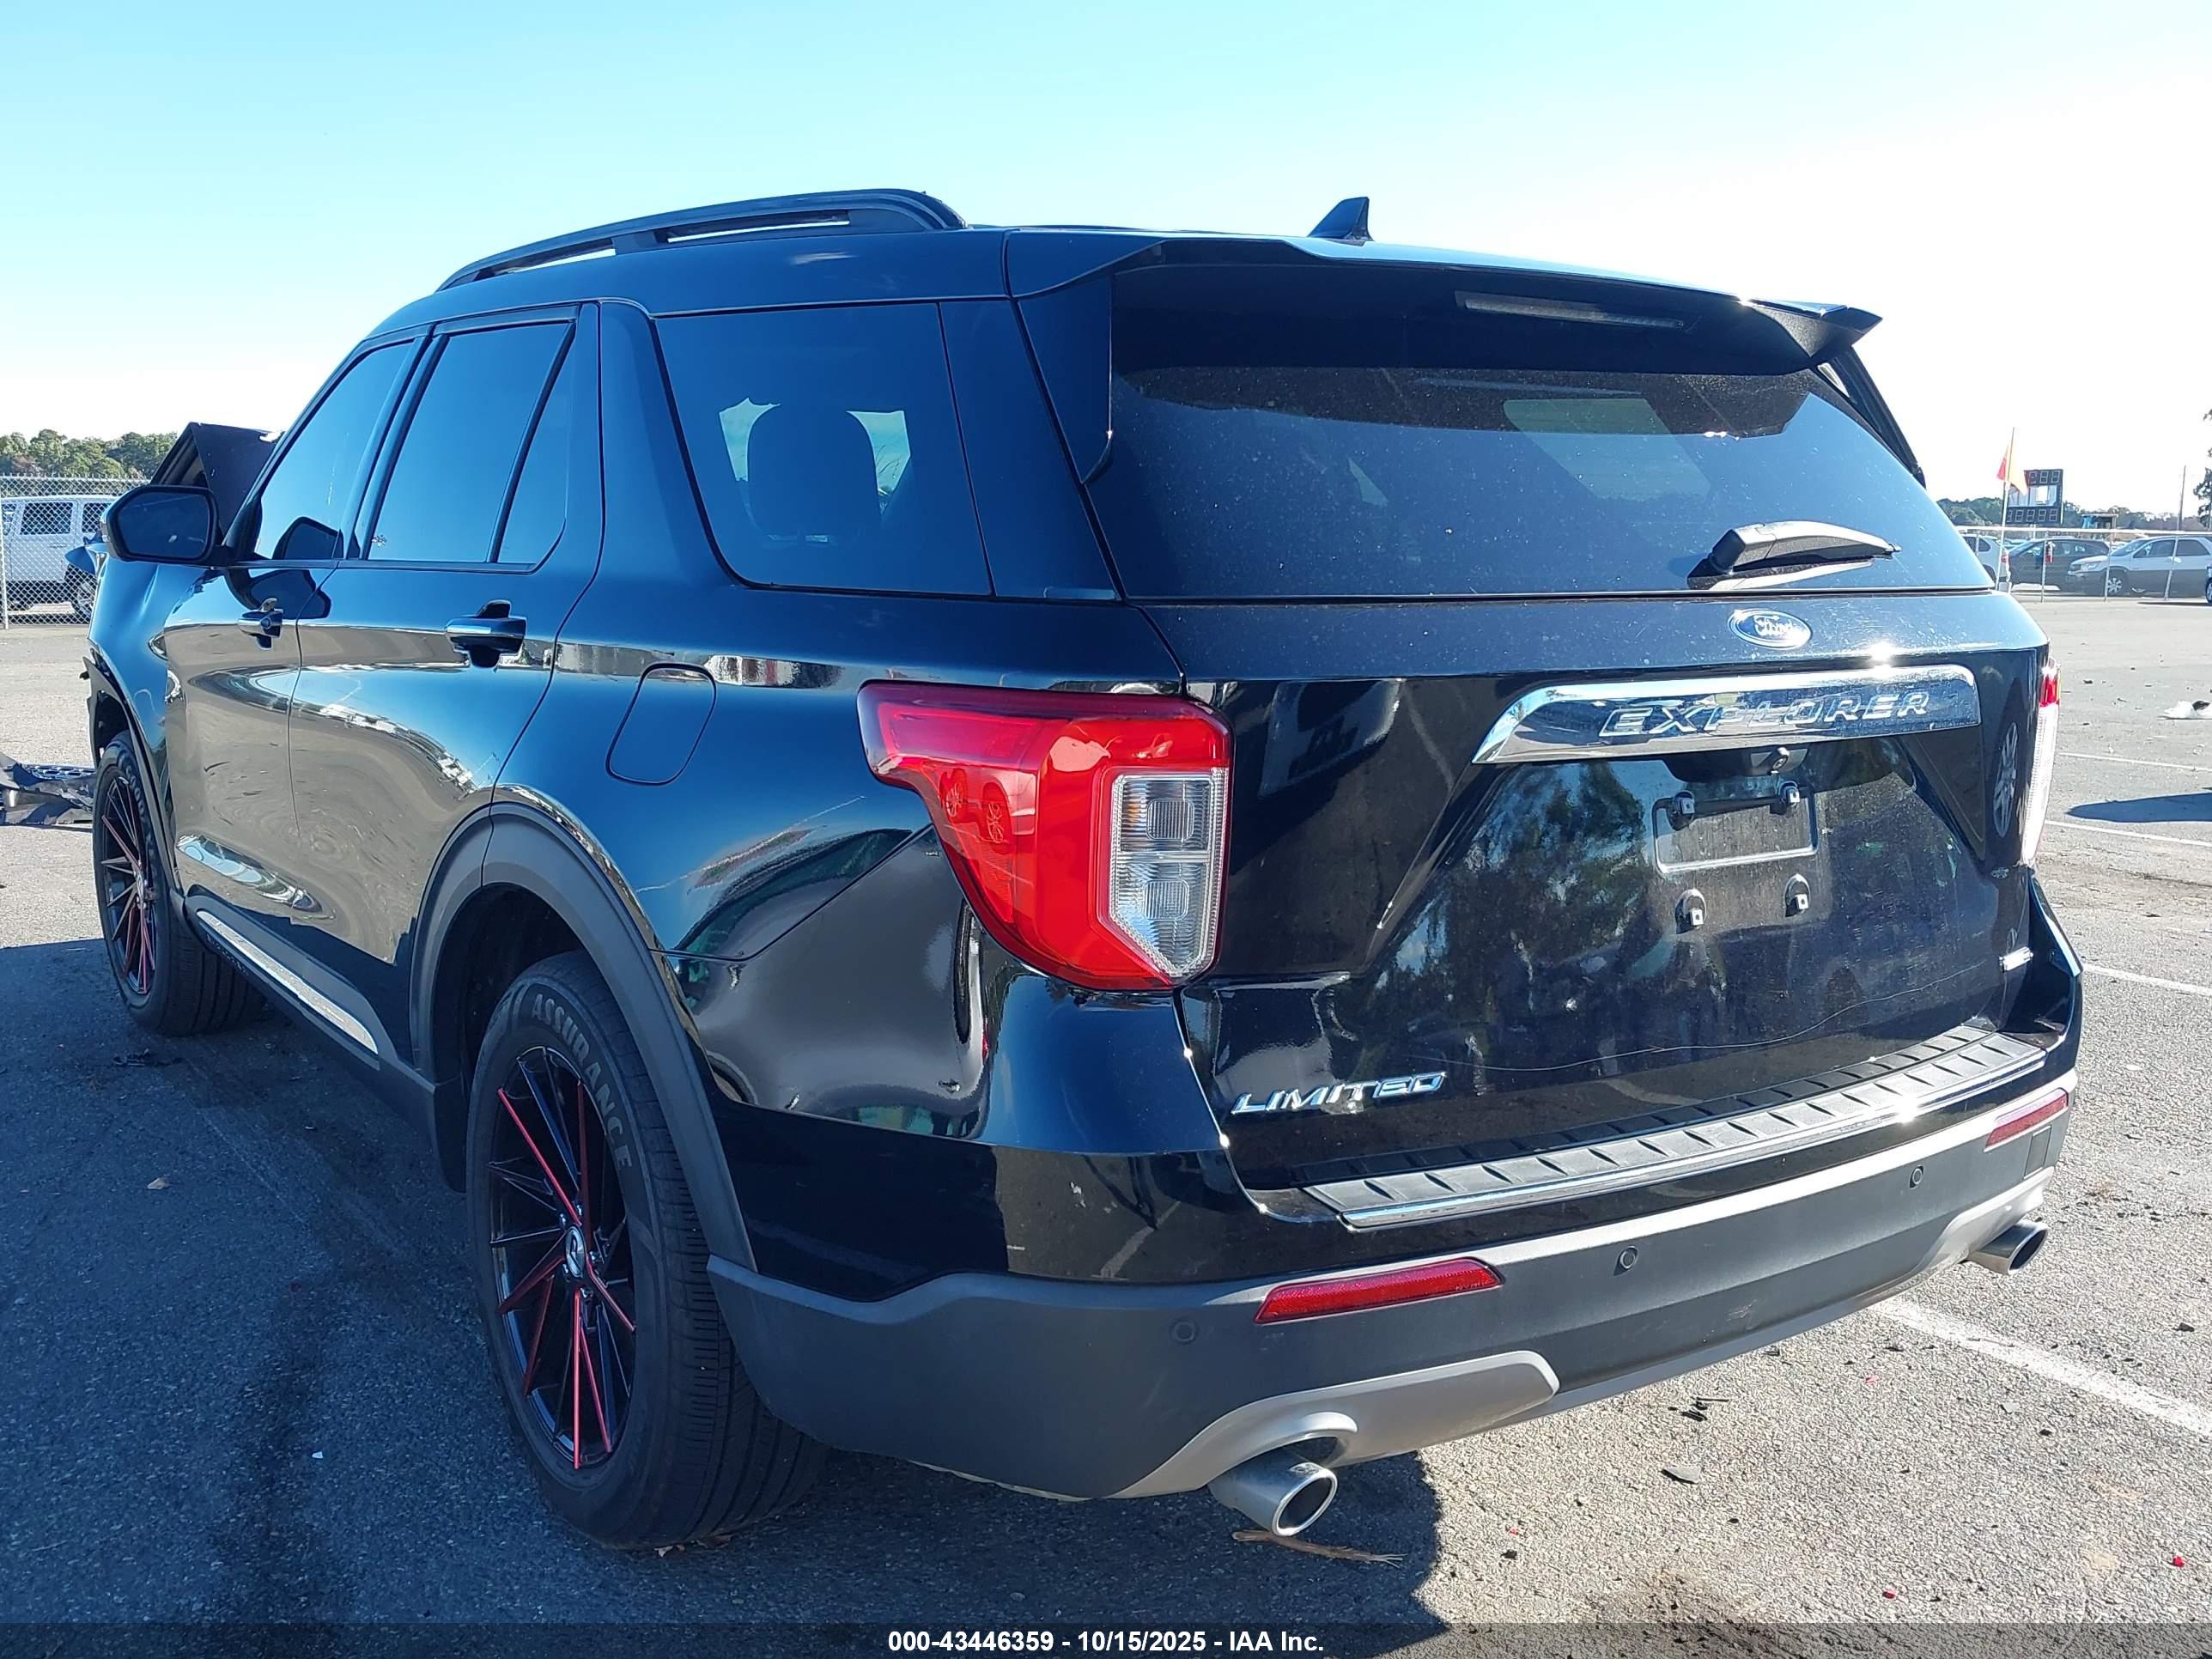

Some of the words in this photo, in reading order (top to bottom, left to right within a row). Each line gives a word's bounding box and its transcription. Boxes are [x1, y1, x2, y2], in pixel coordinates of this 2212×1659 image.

[1753, 615, 1796, 637] Ford
[1598, 690, 1930, 738] EXPLORER
[532, 993, 633, 1169] ASSURANCE
[1231, 1072, 1447, 1115] LIMITED
